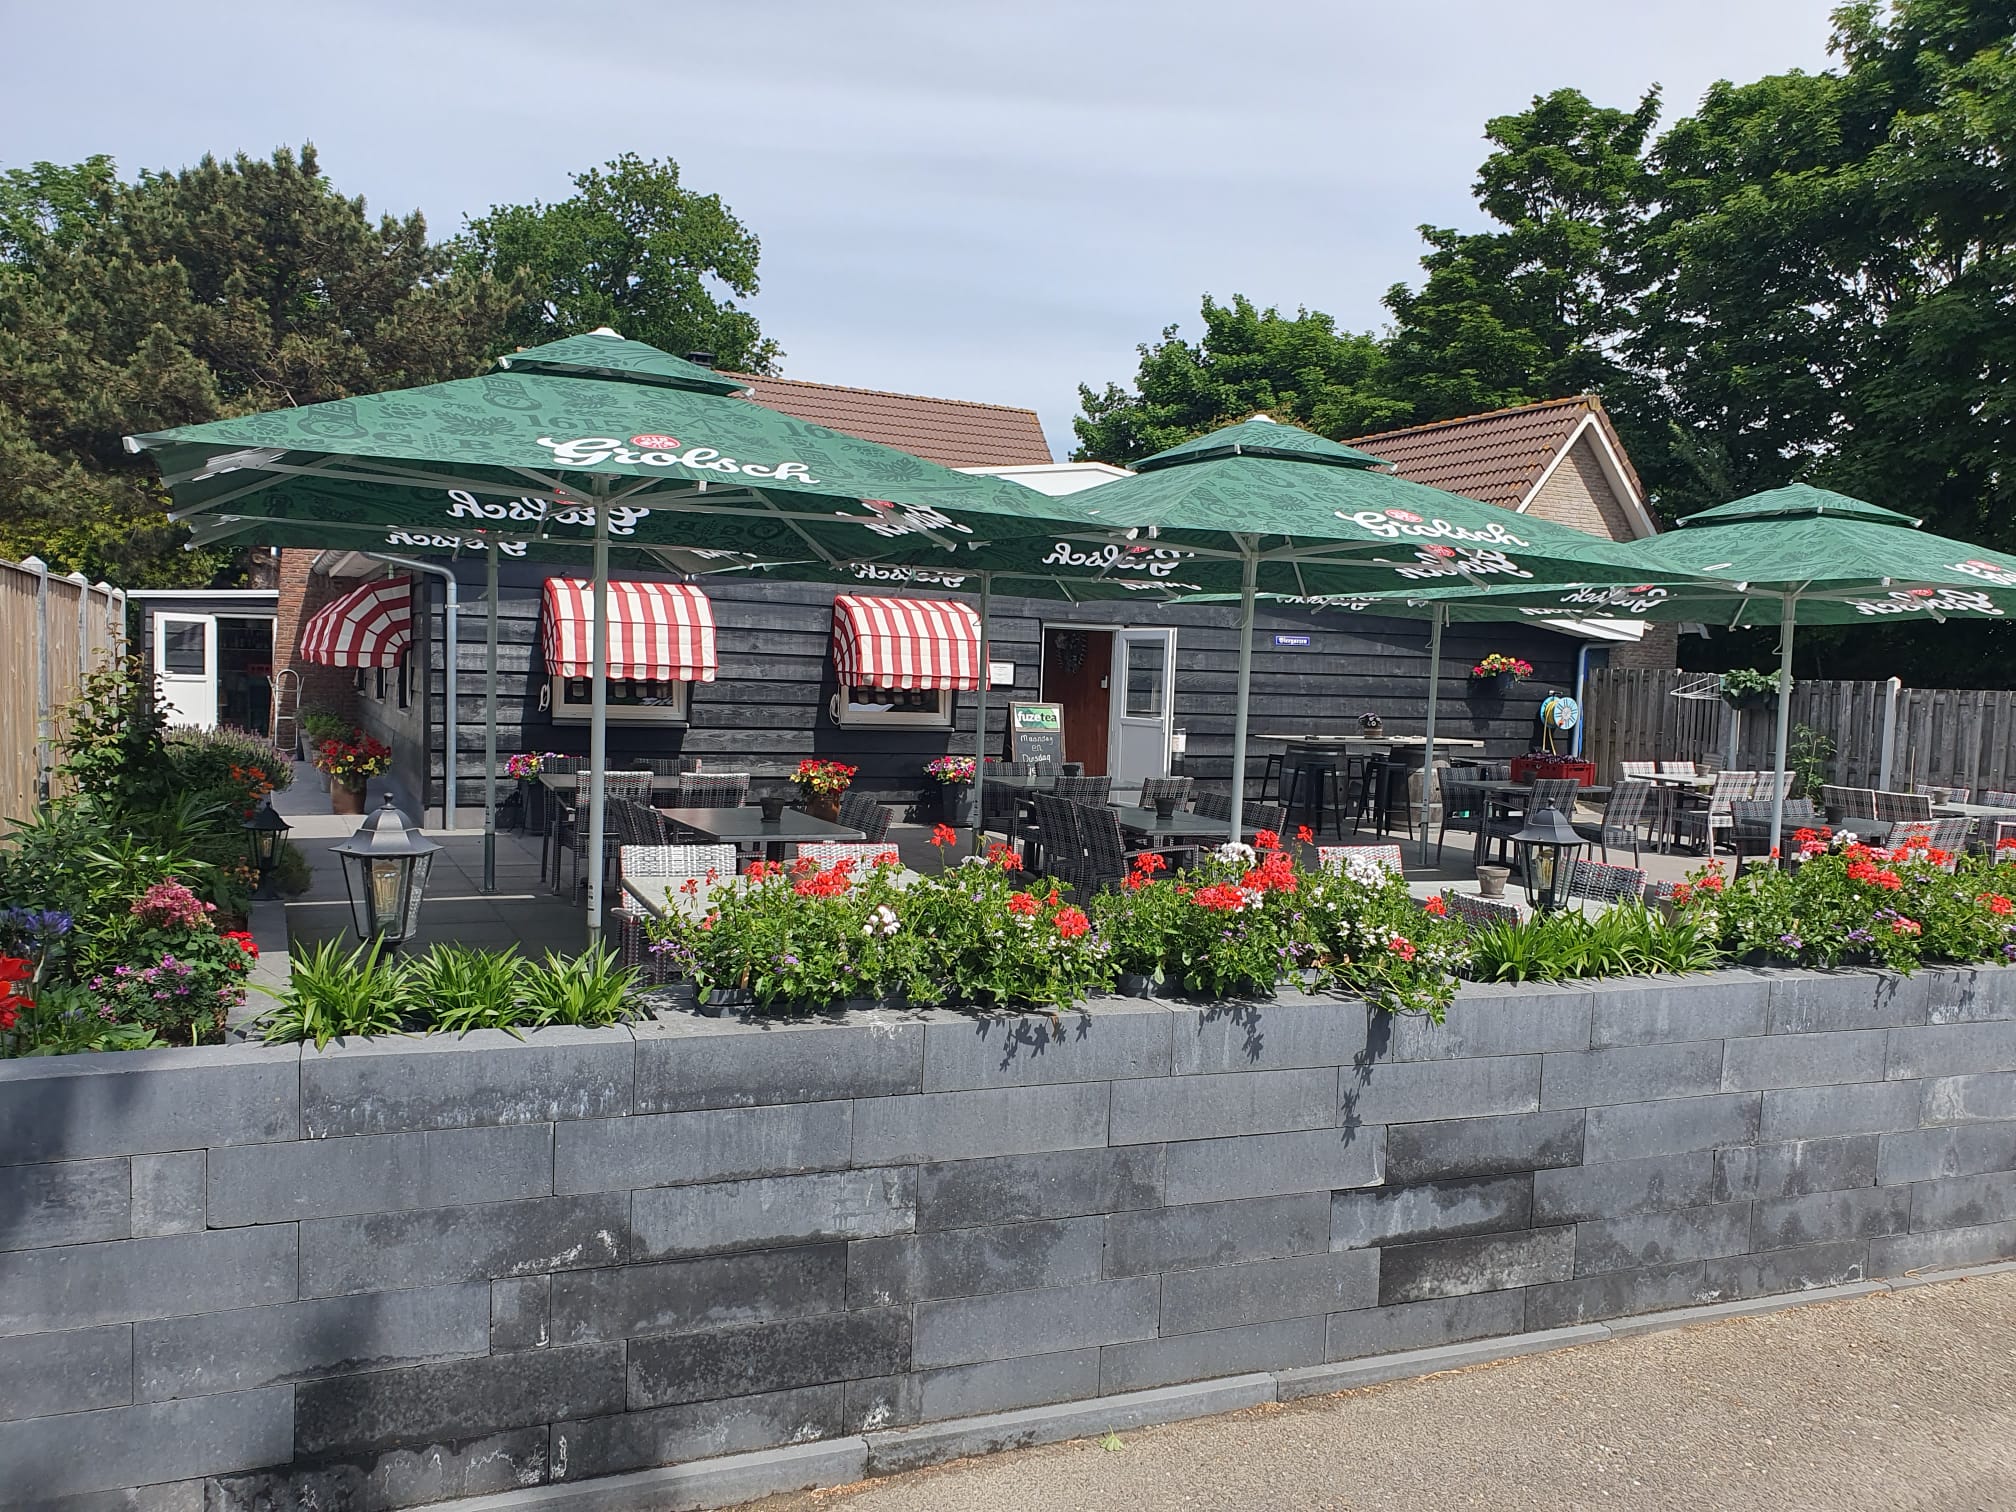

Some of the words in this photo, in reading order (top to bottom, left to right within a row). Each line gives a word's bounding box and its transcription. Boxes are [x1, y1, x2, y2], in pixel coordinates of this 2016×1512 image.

[522, 414, 632, 433] 1615
[536, 437, 820, 484] Grolsch
[1334, 510, 1530, 547] Grolsch
[1018, 711, 1057, 722] fuzetea
